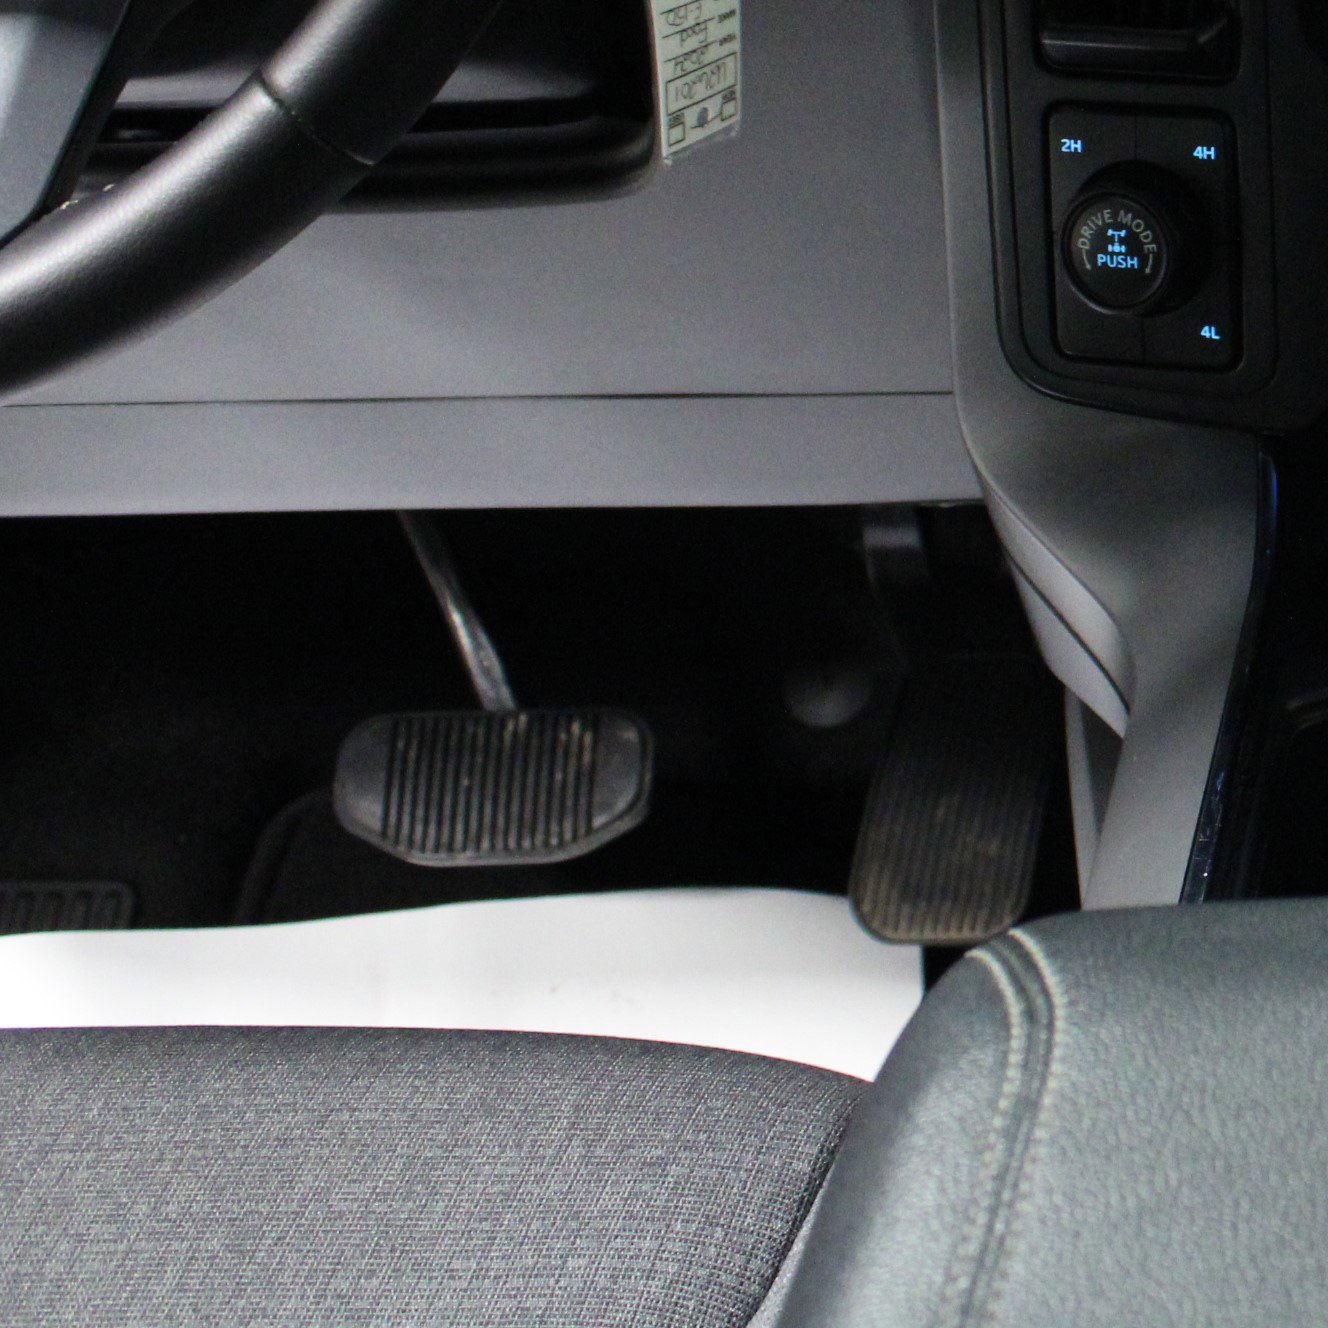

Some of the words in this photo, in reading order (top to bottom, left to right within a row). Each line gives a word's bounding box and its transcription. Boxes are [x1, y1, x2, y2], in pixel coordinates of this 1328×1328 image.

[1061, 139, 1081, 152] 2H
[1193, 146, 1214, 159] 4H
[1077, 209, 1112, 250] DRIVE
[1117, 210, 1157, 253] MODE
[1097, 254, 1138, 269] PUSH
[1201, 326, 1219, 339] 4L
